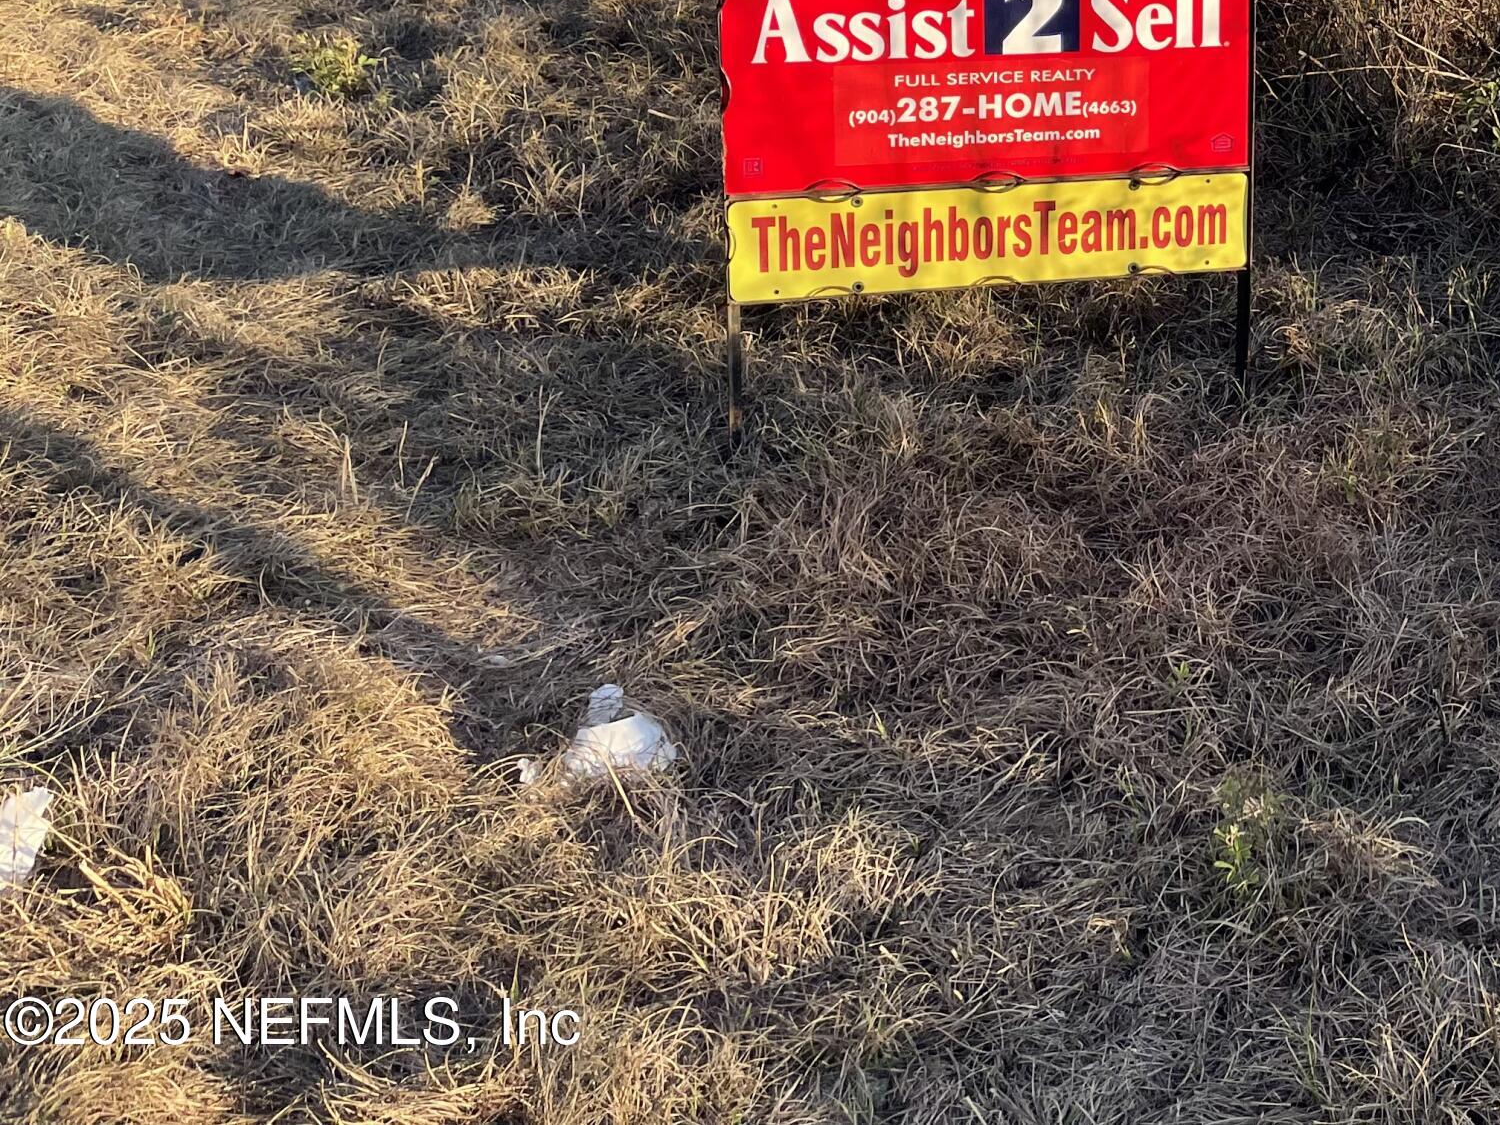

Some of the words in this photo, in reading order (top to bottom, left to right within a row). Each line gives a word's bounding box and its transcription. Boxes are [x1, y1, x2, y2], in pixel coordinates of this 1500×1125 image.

[894, 74, 940, 87] FULL
[946, 71, 1023, 85] SERVICE
[1030, 68, 1096, 82] REALTY
[887, 126, 1101, 150] TheNeighborsTeam.com
[751, 200, 1227, 278] TheNeighborsTeam.com
